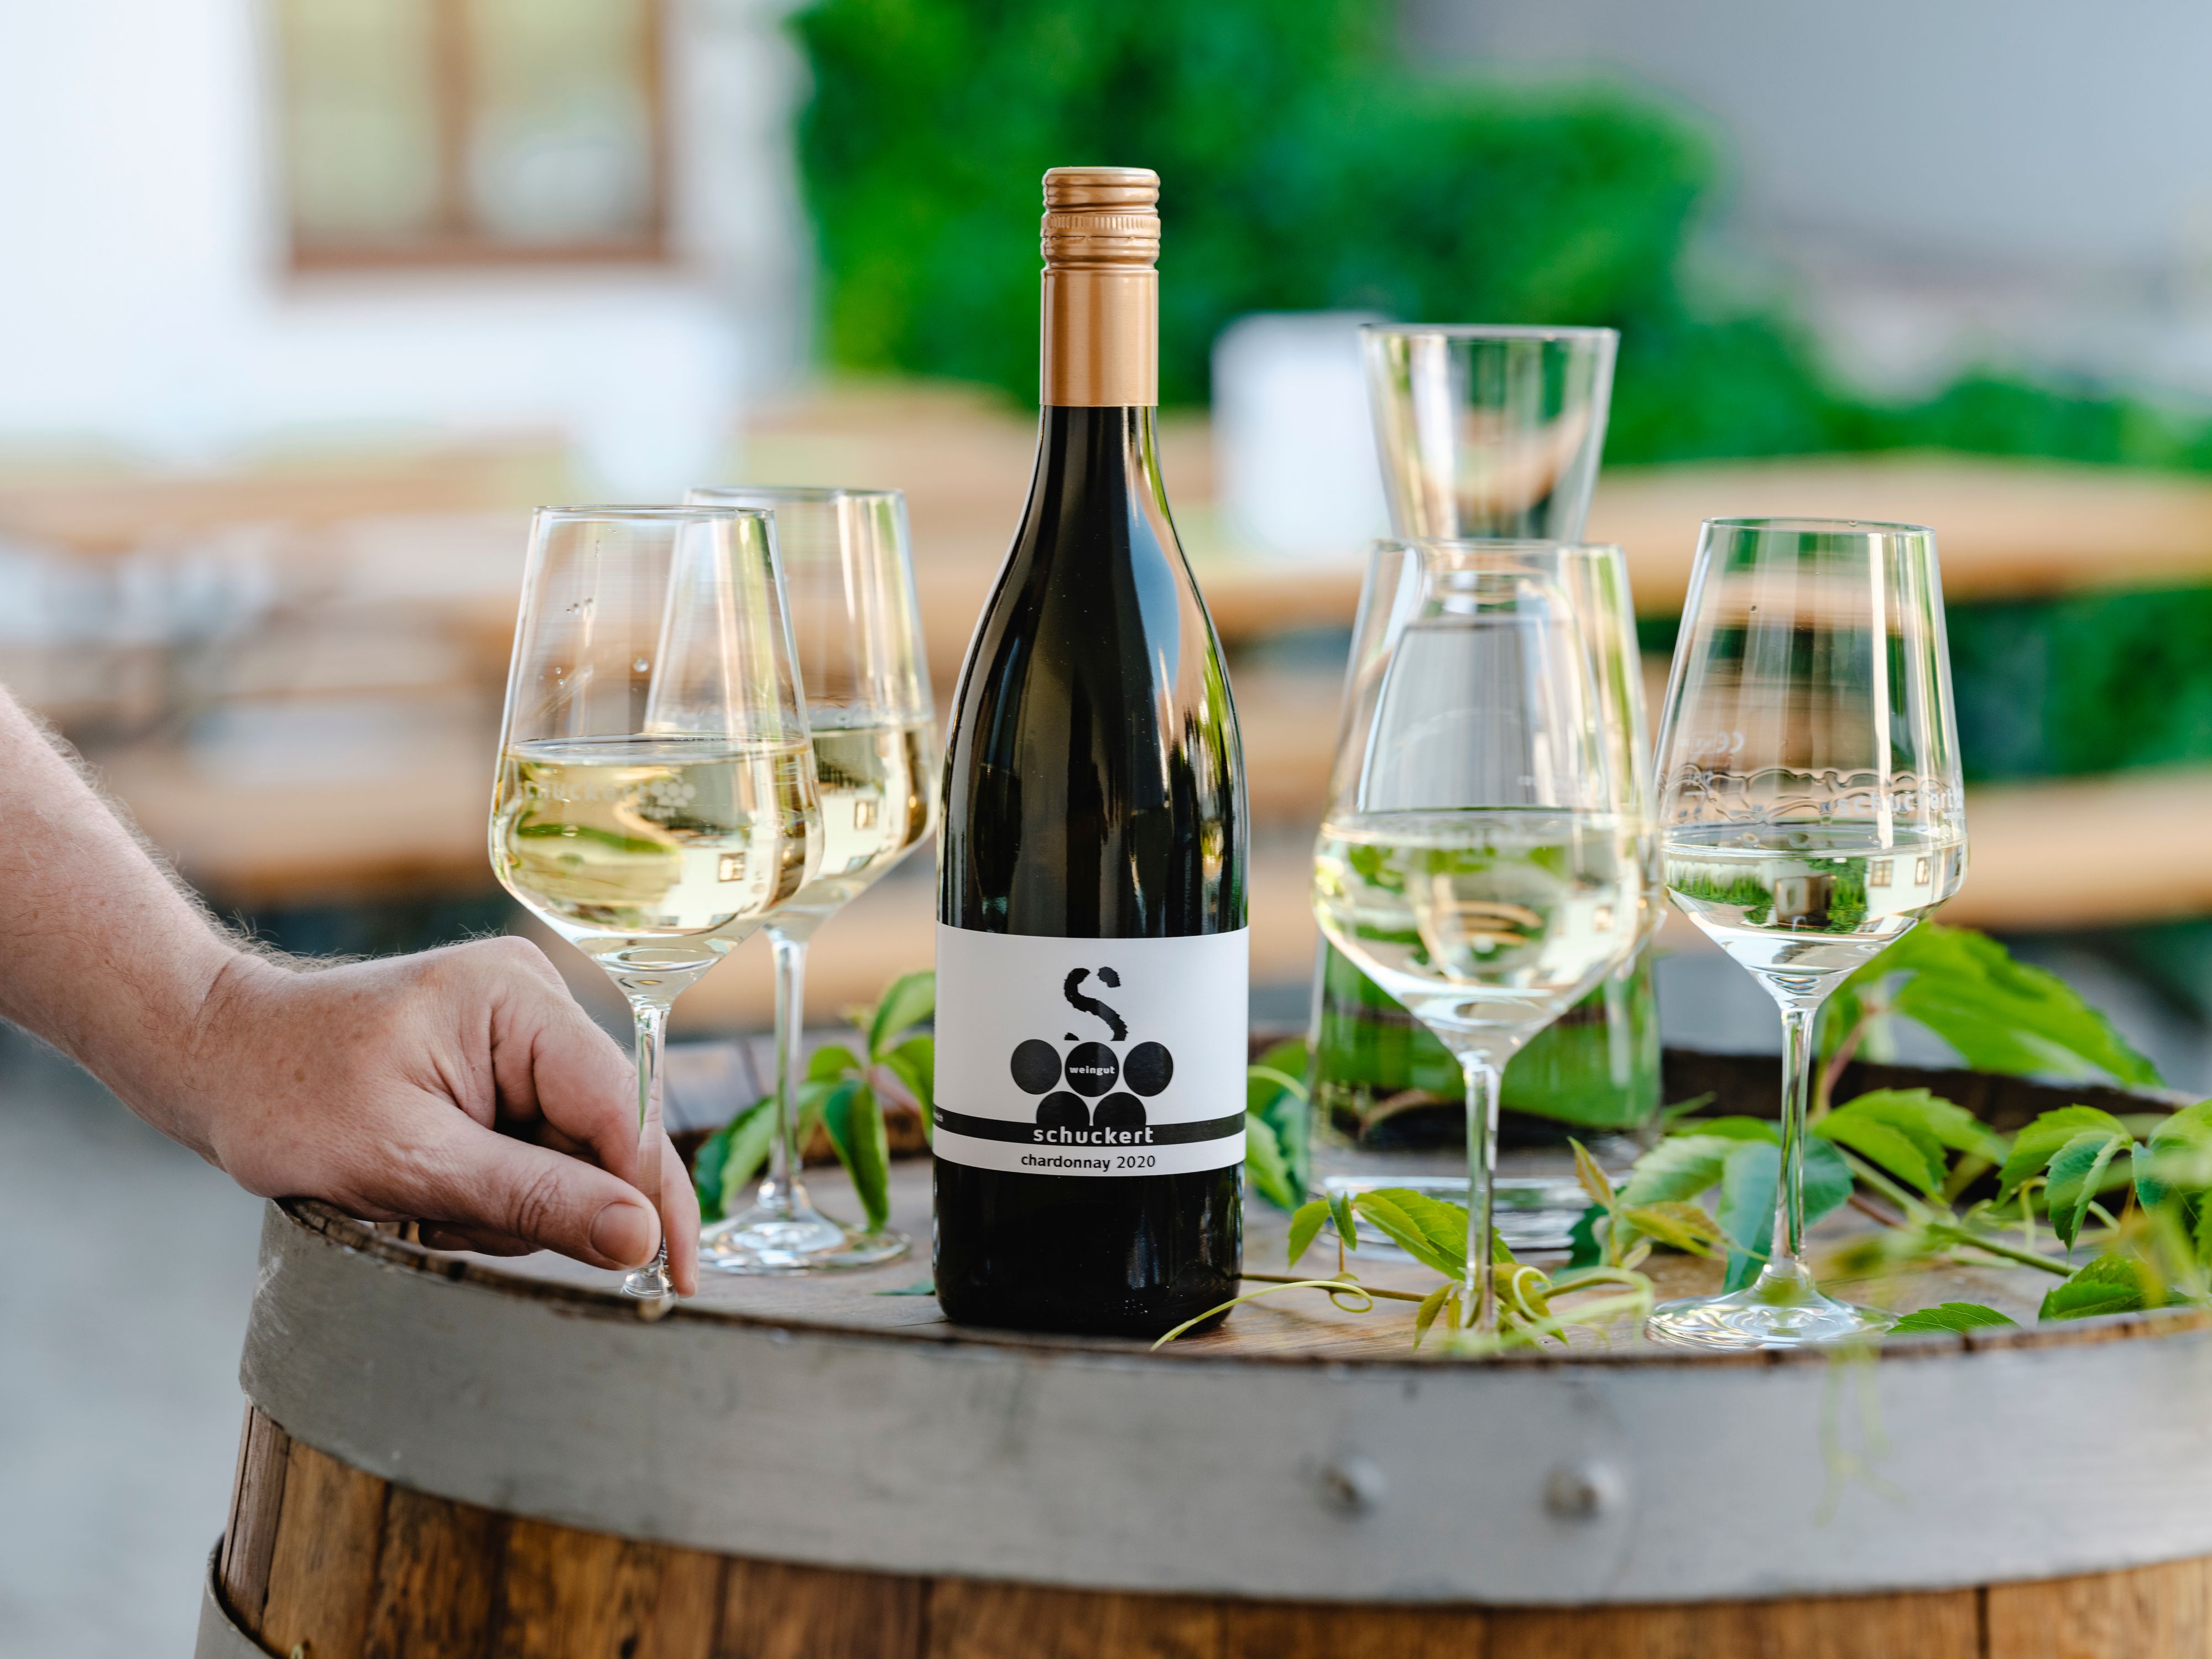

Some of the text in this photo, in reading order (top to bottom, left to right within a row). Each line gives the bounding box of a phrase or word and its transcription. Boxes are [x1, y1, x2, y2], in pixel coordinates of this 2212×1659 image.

[1837, 787, 1954, 815] schucert
[1069, 1066, 1115, 1076] weingut
[1032, 1125, 1154, 1144] schuckert
[1021, 1154, 1156, 1172] chardonnay 2020
